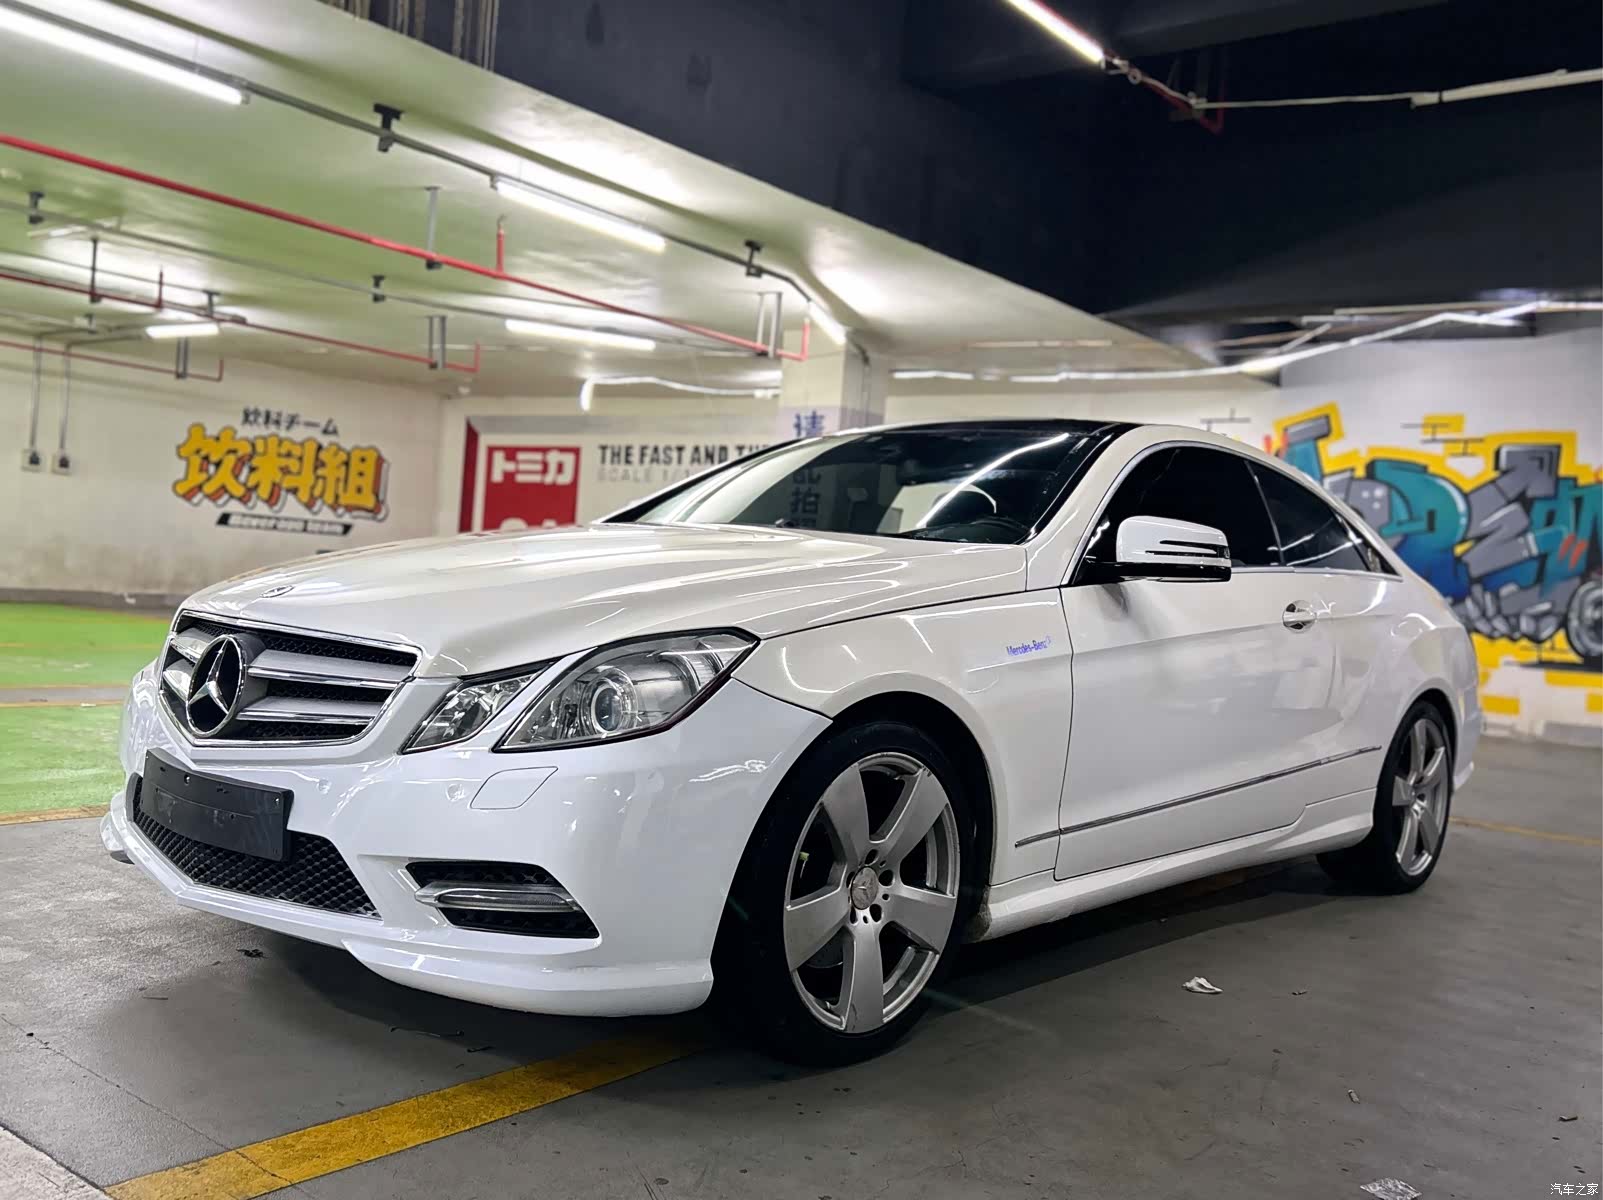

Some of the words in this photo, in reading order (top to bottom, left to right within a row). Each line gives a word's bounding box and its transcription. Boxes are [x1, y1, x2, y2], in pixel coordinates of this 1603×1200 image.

[491, 450, 576, 486] トミカ
[598, 445, 633, 465] THE
[639, 445, 685, 465] FAST
[690, 445, 729, 465] AND
